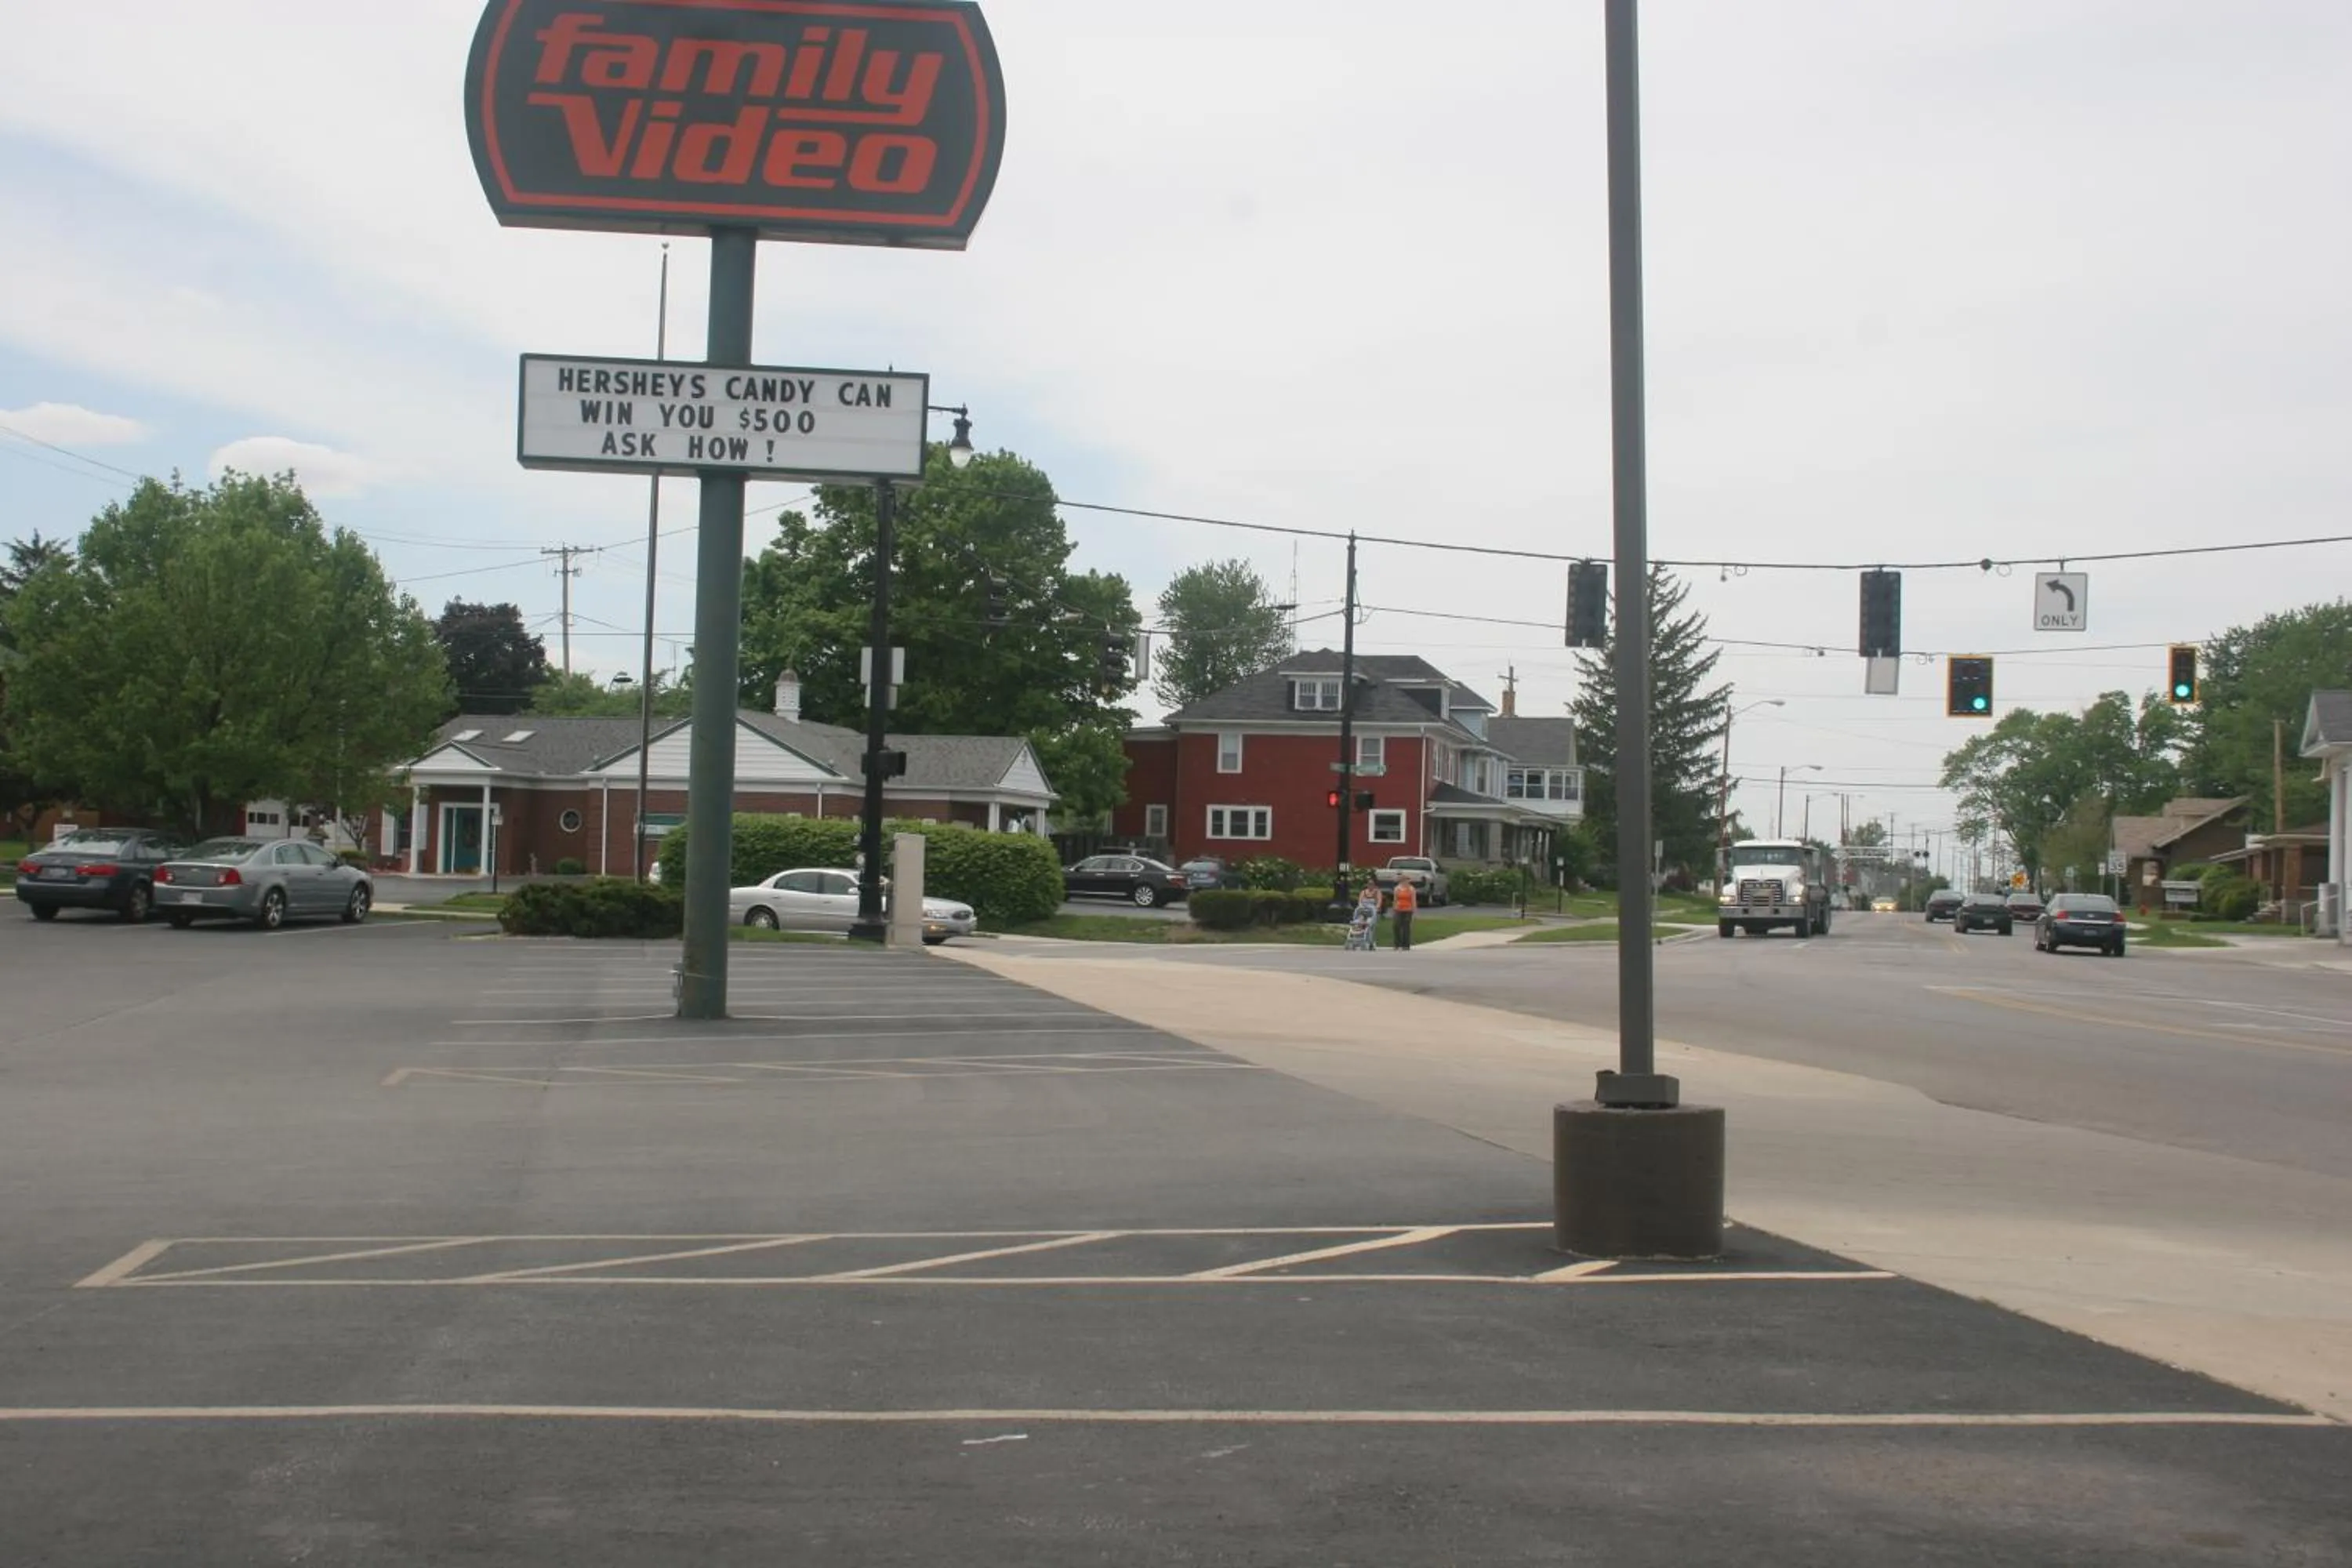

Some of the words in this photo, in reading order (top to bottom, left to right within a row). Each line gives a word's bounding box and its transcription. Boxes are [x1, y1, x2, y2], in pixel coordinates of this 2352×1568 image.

[535, 13, 944, 125] family
[526, 92, 937, 194] Video
[558, 368, 706, 399] HERSHEYS
[725, 376, 815, 405] CANDY
[838, 382, 892, 408] CAN
[580, 400, 632, 426] WIN
[660, 404, 714, 430] YOU
[739, 406, 815, 434] $500
[601, 431, 657, 457] ASK
[688, 435, 749, 461] HOW
[2041, 614, 2078, 626] ONLY
